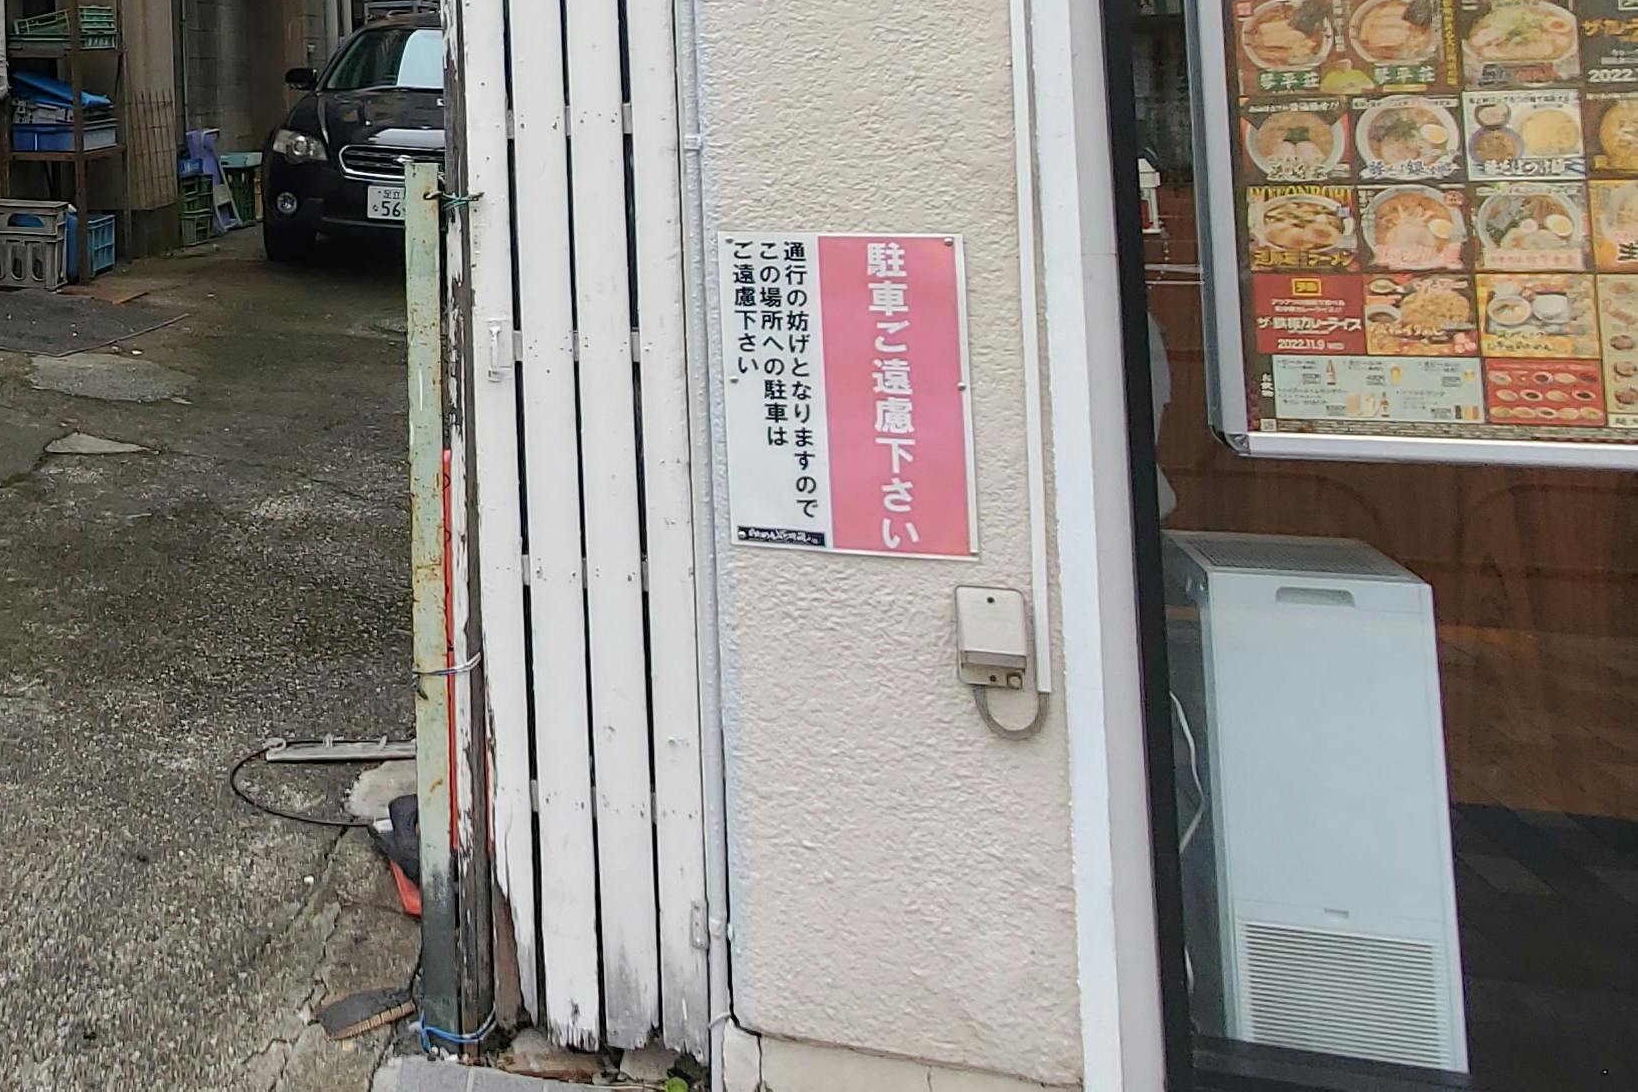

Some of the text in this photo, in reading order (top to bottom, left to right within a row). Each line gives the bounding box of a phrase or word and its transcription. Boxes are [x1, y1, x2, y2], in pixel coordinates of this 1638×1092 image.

[732, 240, 760, 375] ご遠慮下さい
[759, 241, 789, 447] この場所への駐車は
[783, 240, 819, 518] 通行の妨げとなりますので
[866, 242, 920, 549] 駐車ご遠慮下さい
